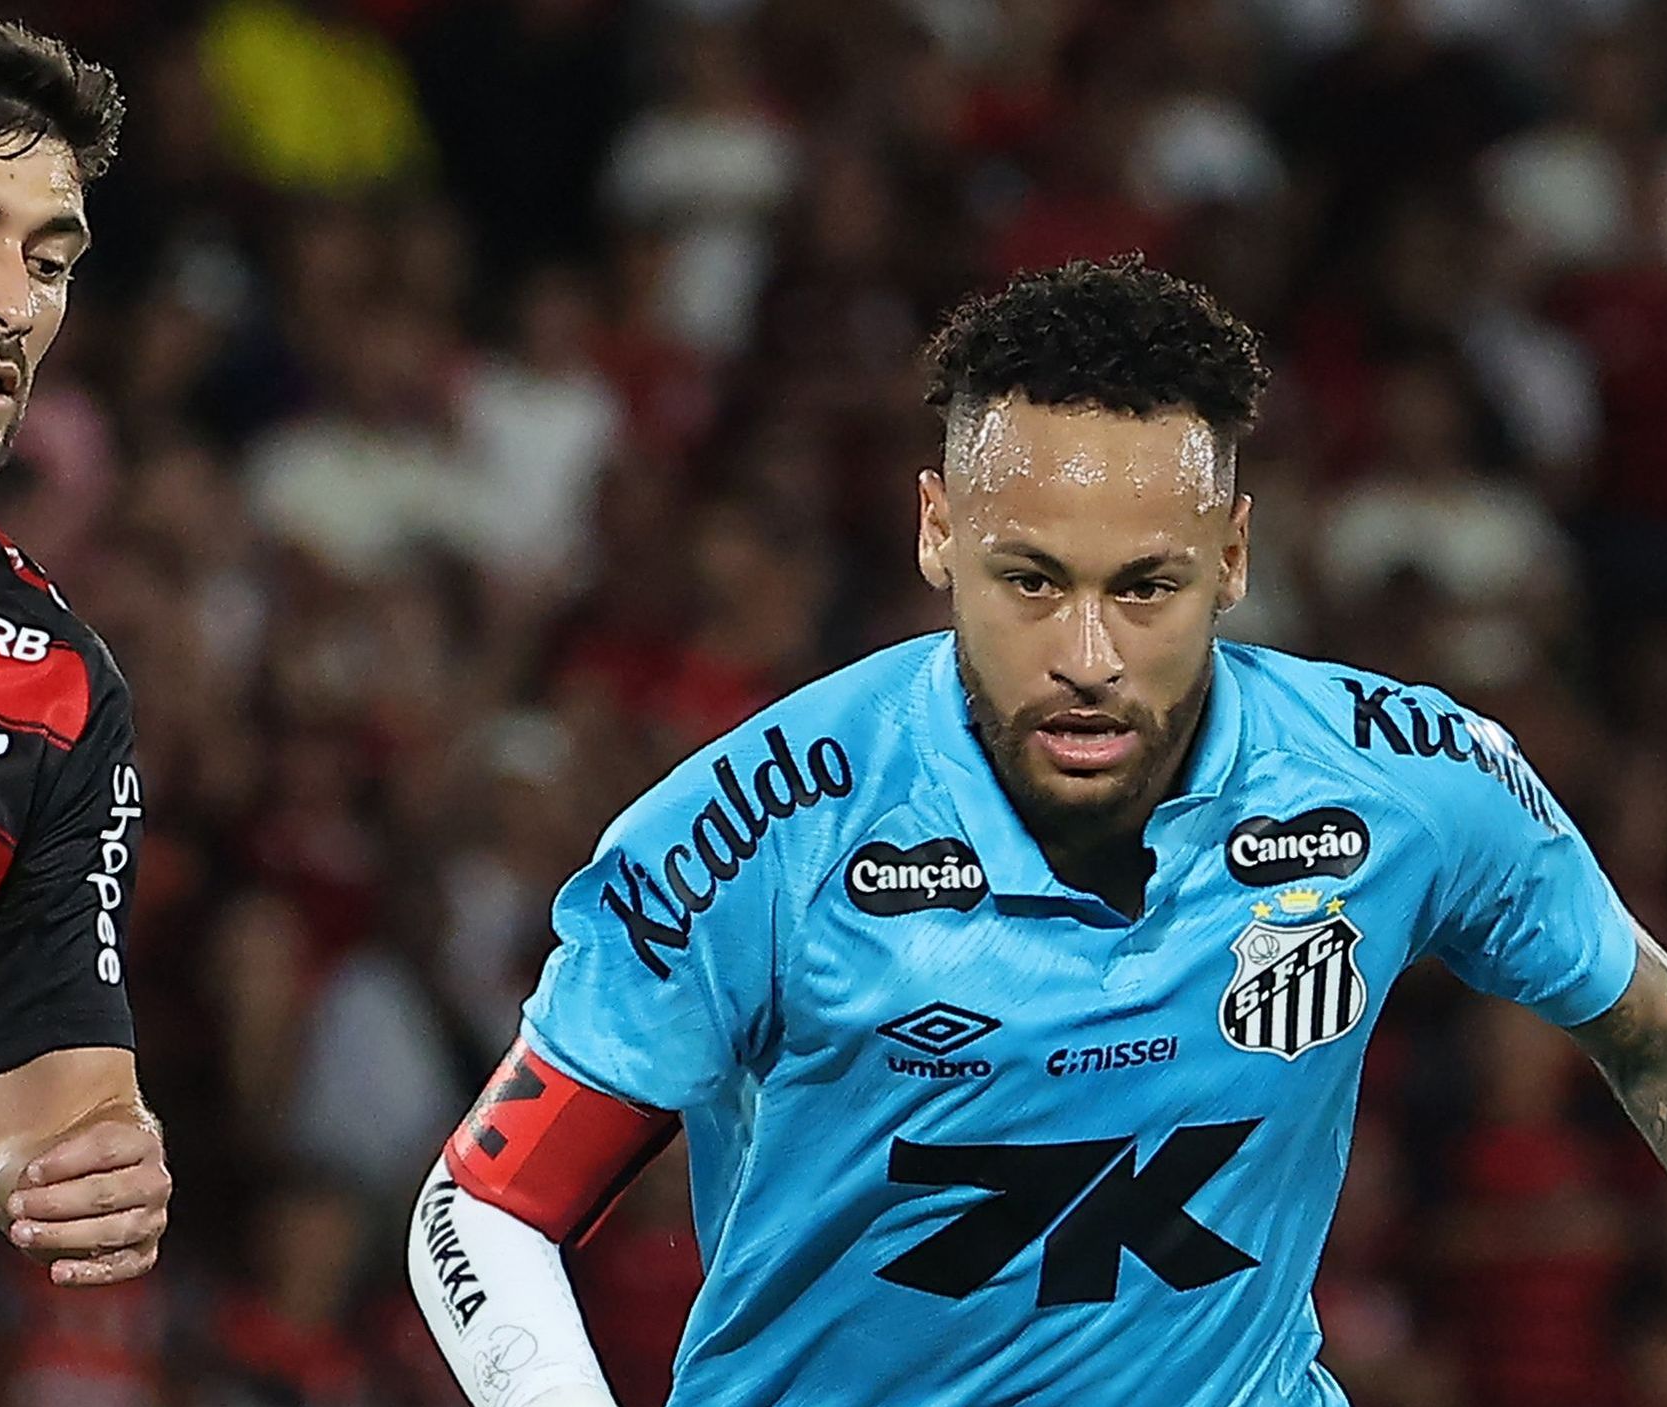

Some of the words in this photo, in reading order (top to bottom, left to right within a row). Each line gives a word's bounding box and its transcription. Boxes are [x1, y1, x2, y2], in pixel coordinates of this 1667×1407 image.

[1329, 676, 1561, 837] Kica
[86, 764, 142, 984] Shopee
[600, 724, 853, 981] Kicaldo
[851, 855, 983, 900] Canção
[1232, 824, 1363, 868] Canção
[887, 1056, 992, 1079] umbro
[873, 1116, 1266, 1308] 7K
